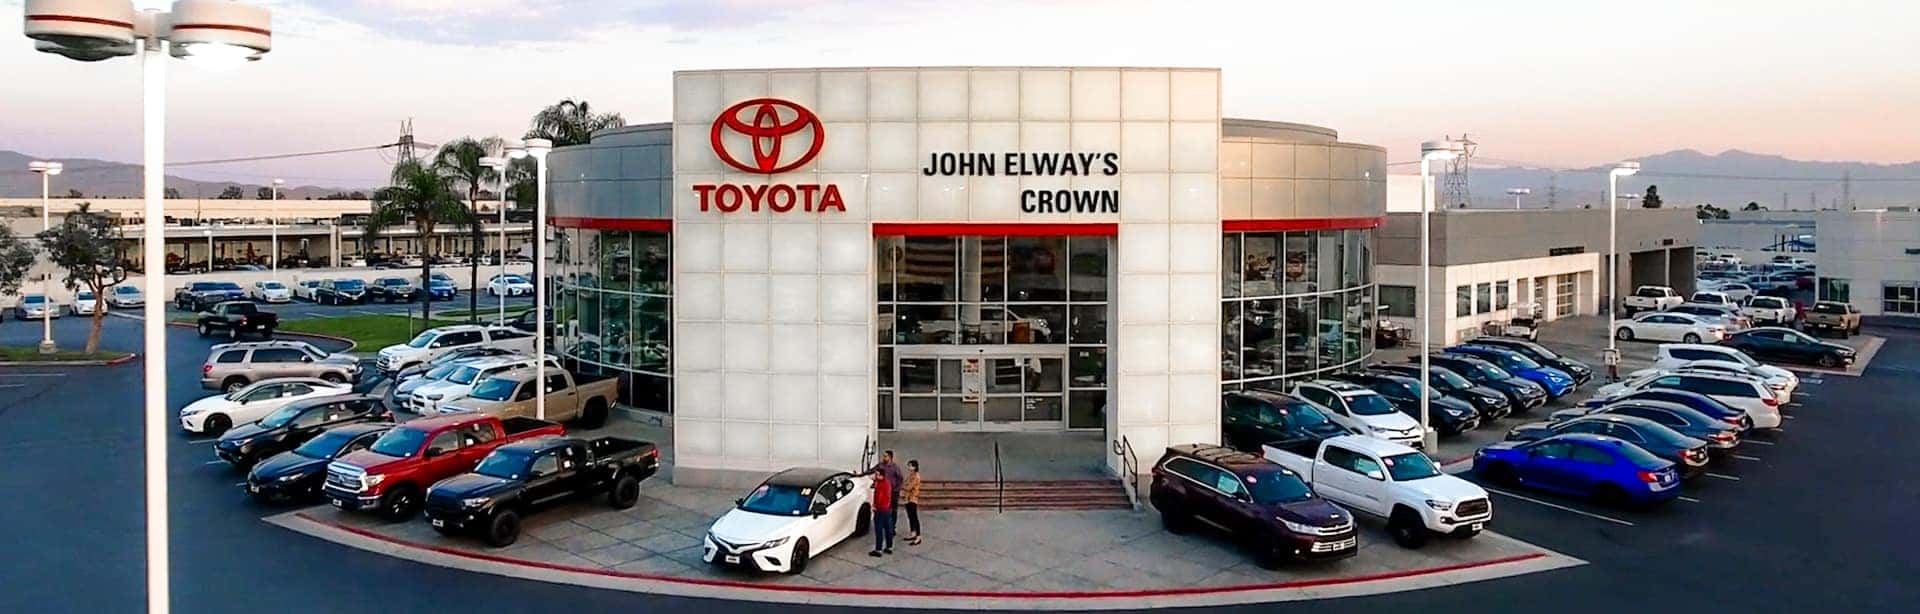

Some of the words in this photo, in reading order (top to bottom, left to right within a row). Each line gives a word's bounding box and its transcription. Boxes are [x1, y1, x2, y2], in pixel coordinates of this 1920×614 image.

[923, 152, 996, 177] JOHN
[1004, 152, 1119, 177] ELWAY'S
[692, 183, 846, 213] TOYOTA
[1020, 189, 1119, 214] CROWN
